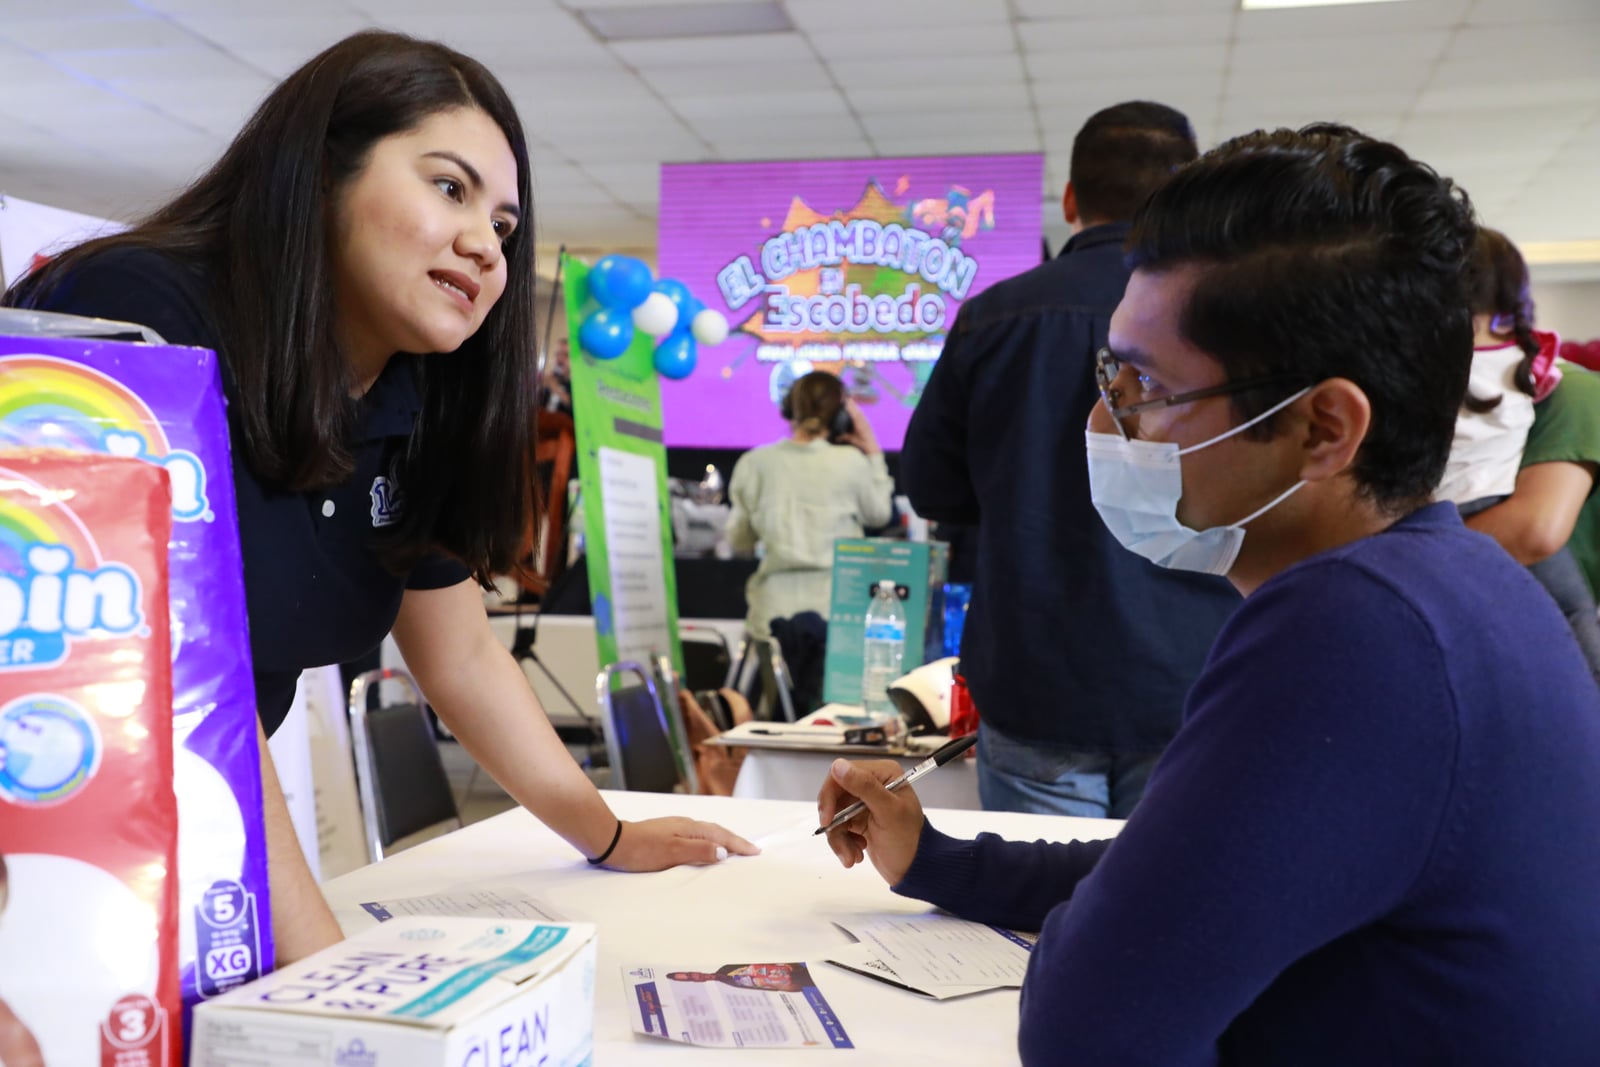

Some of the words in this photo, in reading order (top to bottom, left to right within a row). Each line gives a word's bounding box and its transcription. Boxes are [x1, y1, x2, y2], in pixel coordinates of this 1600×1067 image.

[717, 256, 766, 309] EL
[764, 284, 945, 332] Escobedo
[214, 893, 235, 920] 5
[212, 950, 246, 974] XG
[261, 951, 405, 1004] CLEAN
[354, 953, 470, 997] PURE
[119, 1009, 146, 1041] 3
